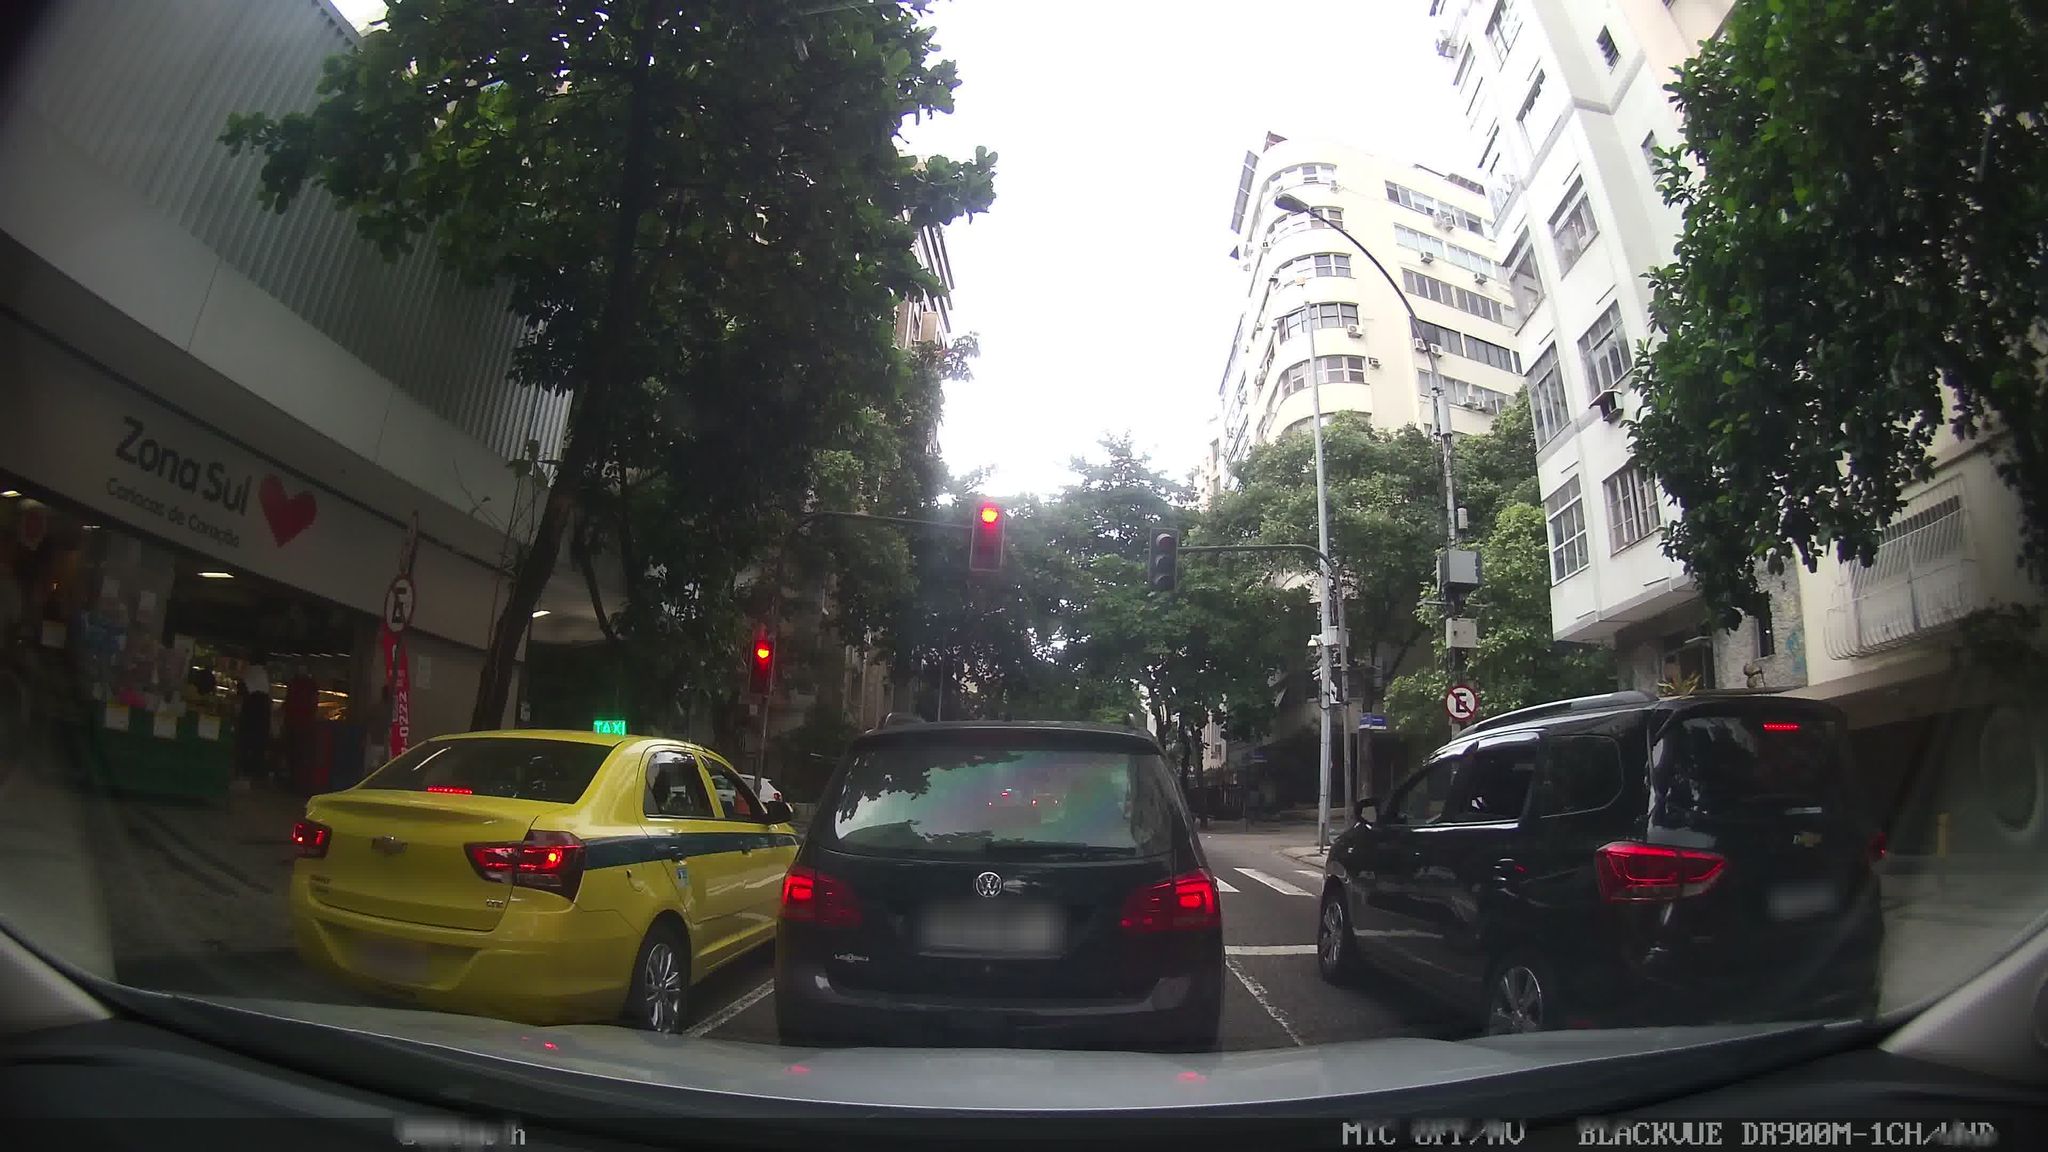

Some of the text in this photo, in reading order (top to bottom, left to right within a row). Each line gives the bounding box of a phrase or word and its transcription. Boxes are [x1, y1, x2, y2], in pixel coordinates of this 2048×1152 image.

[116, 416, 252, 517] Zona Sul
[106, 477, 240, 548] Cariocas de Coração
[1455, 692, 1467, 713] E
[593, 719, 626, 736] TAXI
